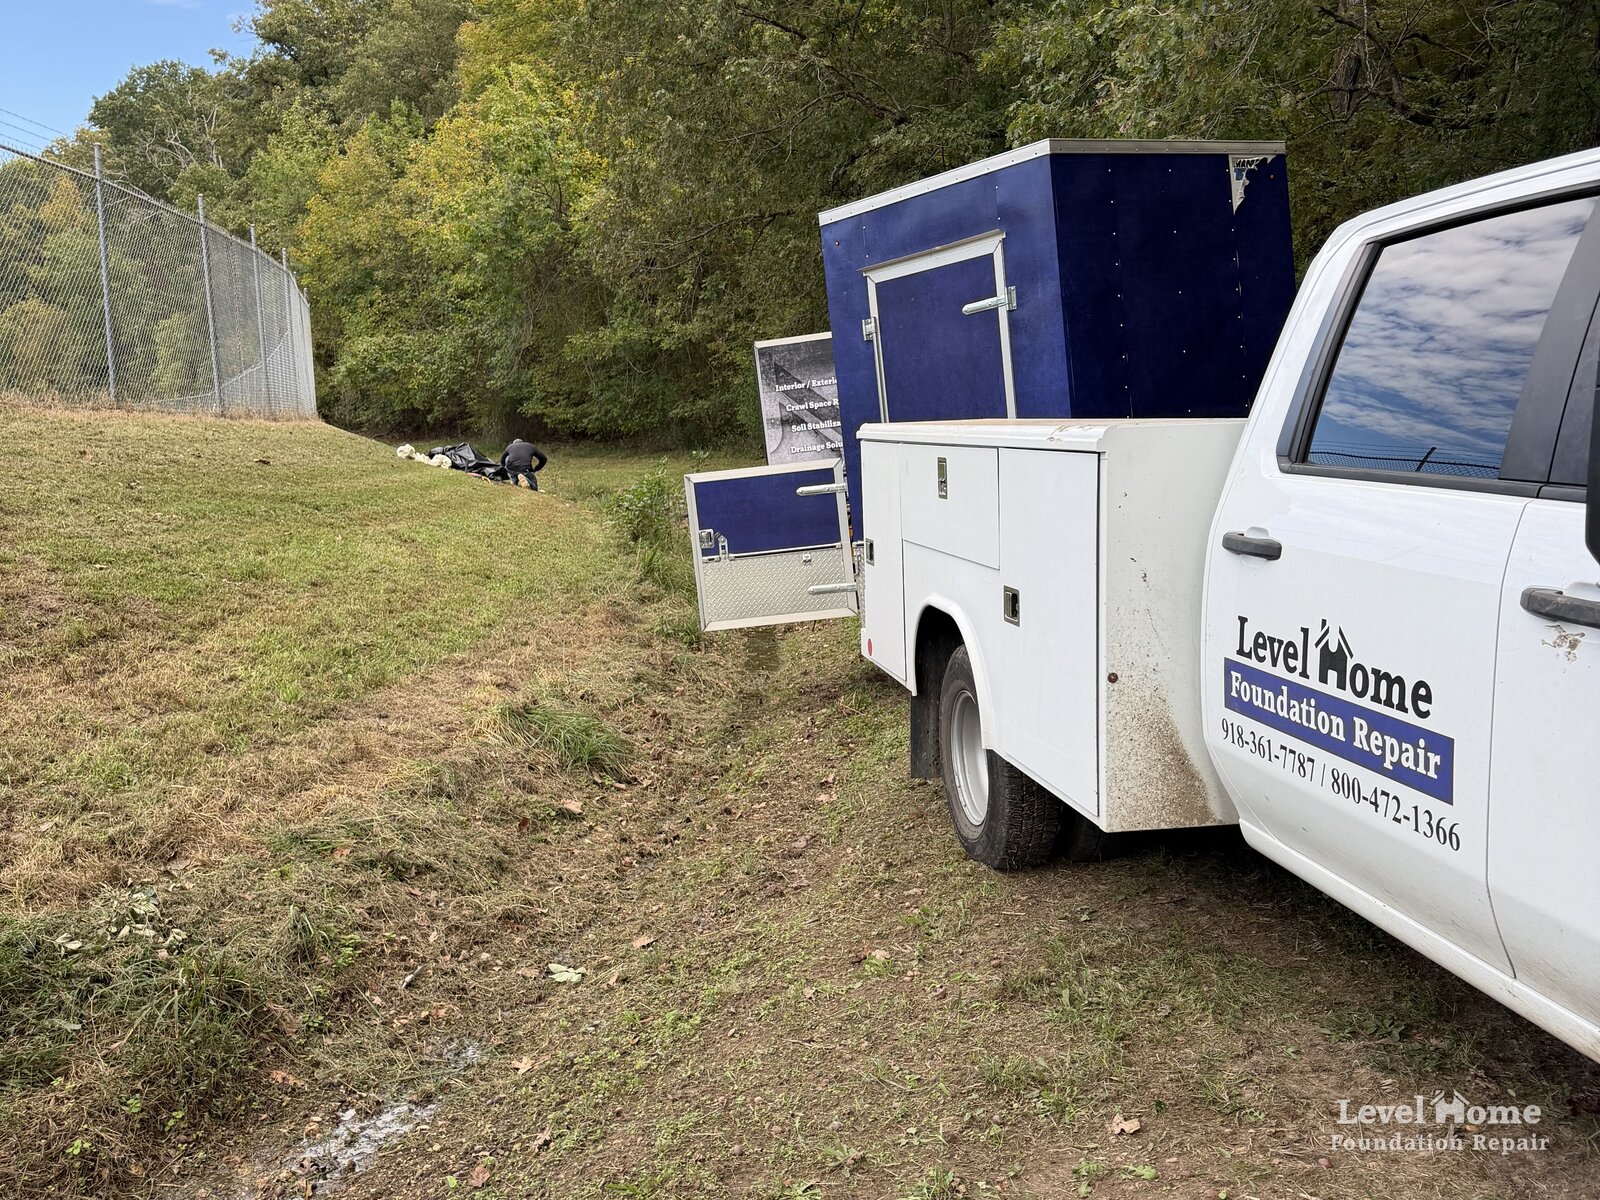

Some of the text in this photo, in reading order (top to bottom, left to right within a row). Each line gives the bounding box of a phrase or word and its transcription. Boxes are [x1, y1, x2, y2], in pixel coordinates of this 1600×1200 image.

[775, 382, 806, 392] Interior
[786, 403, 808, 412] Crawl
[809, 400, 832, 408] Space
[792, 421, 841, 432] Soil Stabiliza
[790, 445, 825, 453] Drainage
[1236, 615, 1309, 679] Level
[1230, 670, 1441, 780] Foundation Repair
[1221, 718, 1315, 782] 918-361-7787
[1331, 768, 1461, 851] 800-472-1366
